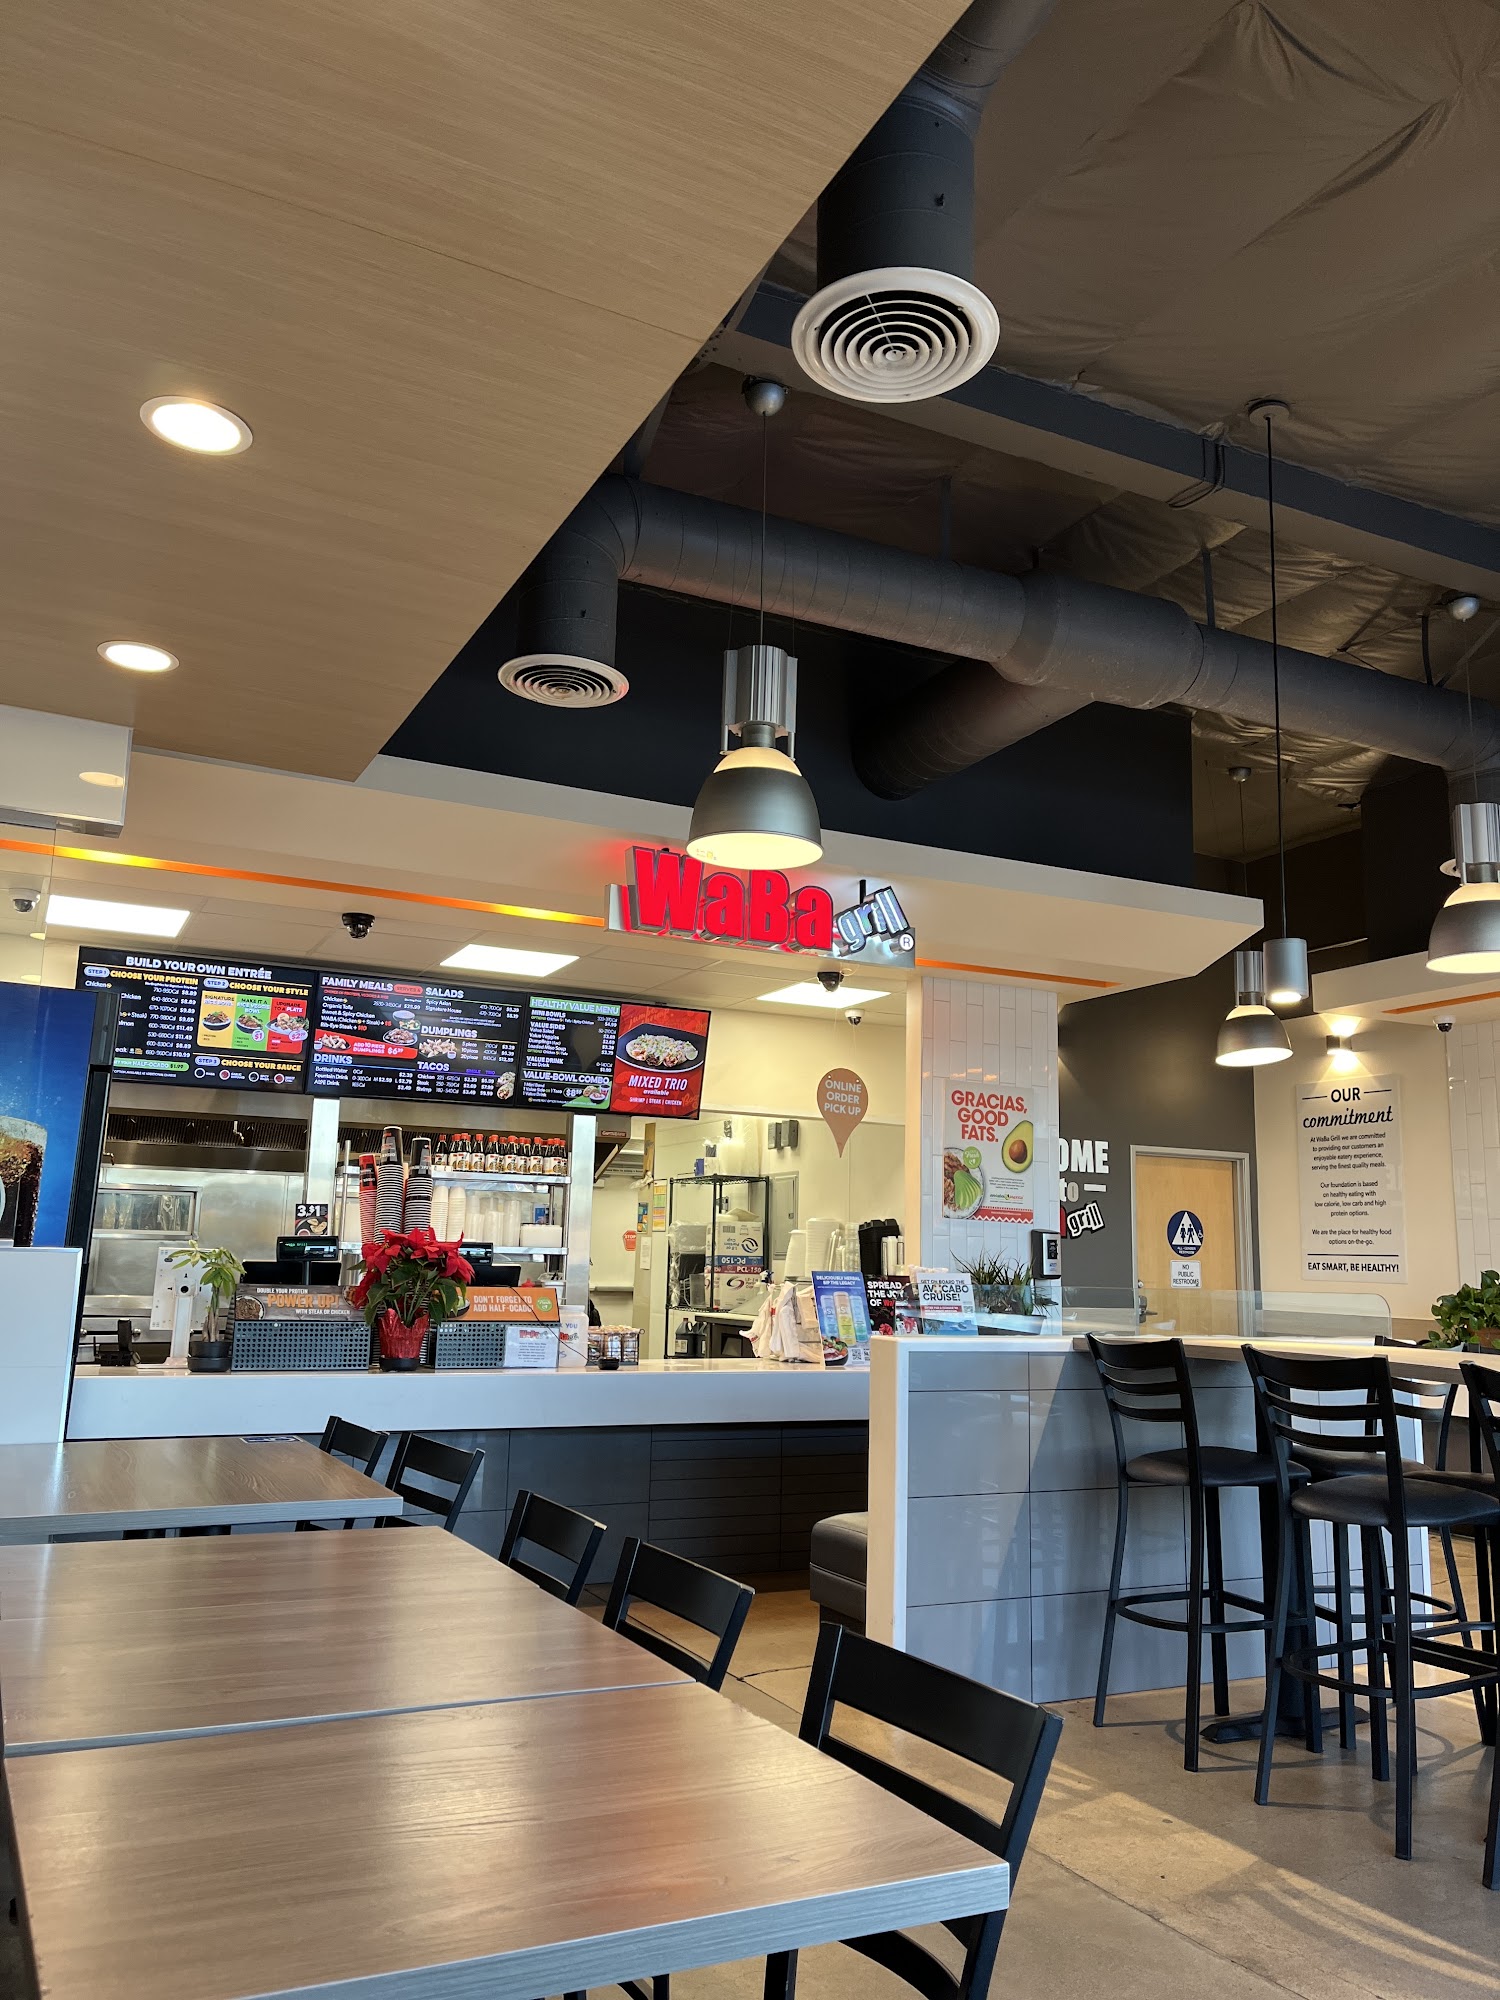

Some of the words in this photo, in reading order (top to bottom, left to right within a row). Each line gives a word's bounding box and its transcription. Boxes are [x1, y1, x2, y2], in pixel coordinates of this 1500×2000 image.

[626, 846, 834, 950] WaBa
[837, 886, 910, 951] grill
[126, 956, 161, 968] BUILD
[164, 960, 196, 972] YOUR
[197, 965, 225, 975] OWN
[228, 968, 272, 980] ENTRÉE
[110, 970, 142, 980] CHOOSE
[143, 973, 164, 982] YOUR
[165, 976, 198, 985] PROTEIN
[322, 977, 359, 988] FAMILY
[359, 980, 393, 992] MEALS
[229, 982, 262, 992] CHOOSE
[263, 985, 284, 994] YOUR
[286, 987, 308, 996] STYLE
[426, 987, 464, 998] SALADS
[531, 999, 568, 1010] HEALTHY
[569, 1002, 594, 1012] VALUE
[596, 1005, 619, 1014] MENU
[421, 1026, 478, 1038] DUMPLINGS
[221, 1059, 253, 1068] CHOOSE
[254, 1062, 276, 1070] YOUR
[313, 1053, 353, 1064] DRINKS
[417, 1062, 449, 1071] TACOS
[523, 1071, 578, 1082] VALUE-BOWL
[579, 1075, 609, 1084] COMBO
[628, 1075, 662, 1088] MIXED
[664, 1078, 688, 1090] TRIO
[825, 1080, 862, 1093] ONLINE
[826, 1092, 859, 1104] ORDER
[952, 1090, 1028, 1114] GRACIAS,
[1331, 1088, 1361, 1102] OUR
[824, 1103, 846, 1114] PICK
[848, 1106, 861, 1116] UP
[958, 1108, 1008, 1126] GOOD
[1303, 1106, 1393, 1128] commitment
[961, 1125, 998, 1142] FATS.
[1060, 1178, 1079, 1202] to
[297, 1205, 306, 1217] 3
[1067, 1202, 1103, 1237] grill
[1322, 1263, 1348, 1272] SMART,
[1362, 1264, 1399, 1272] HEALTHY!
[867, 1281, 902, 1289] SPREAD
[266, 1294, 314, 1308] POWER
[317, 1294, 340, 1309] UP!
[473, 1296, 494, 1304] DON'T
[923, 1293, 960, 1301] CRUISE!
